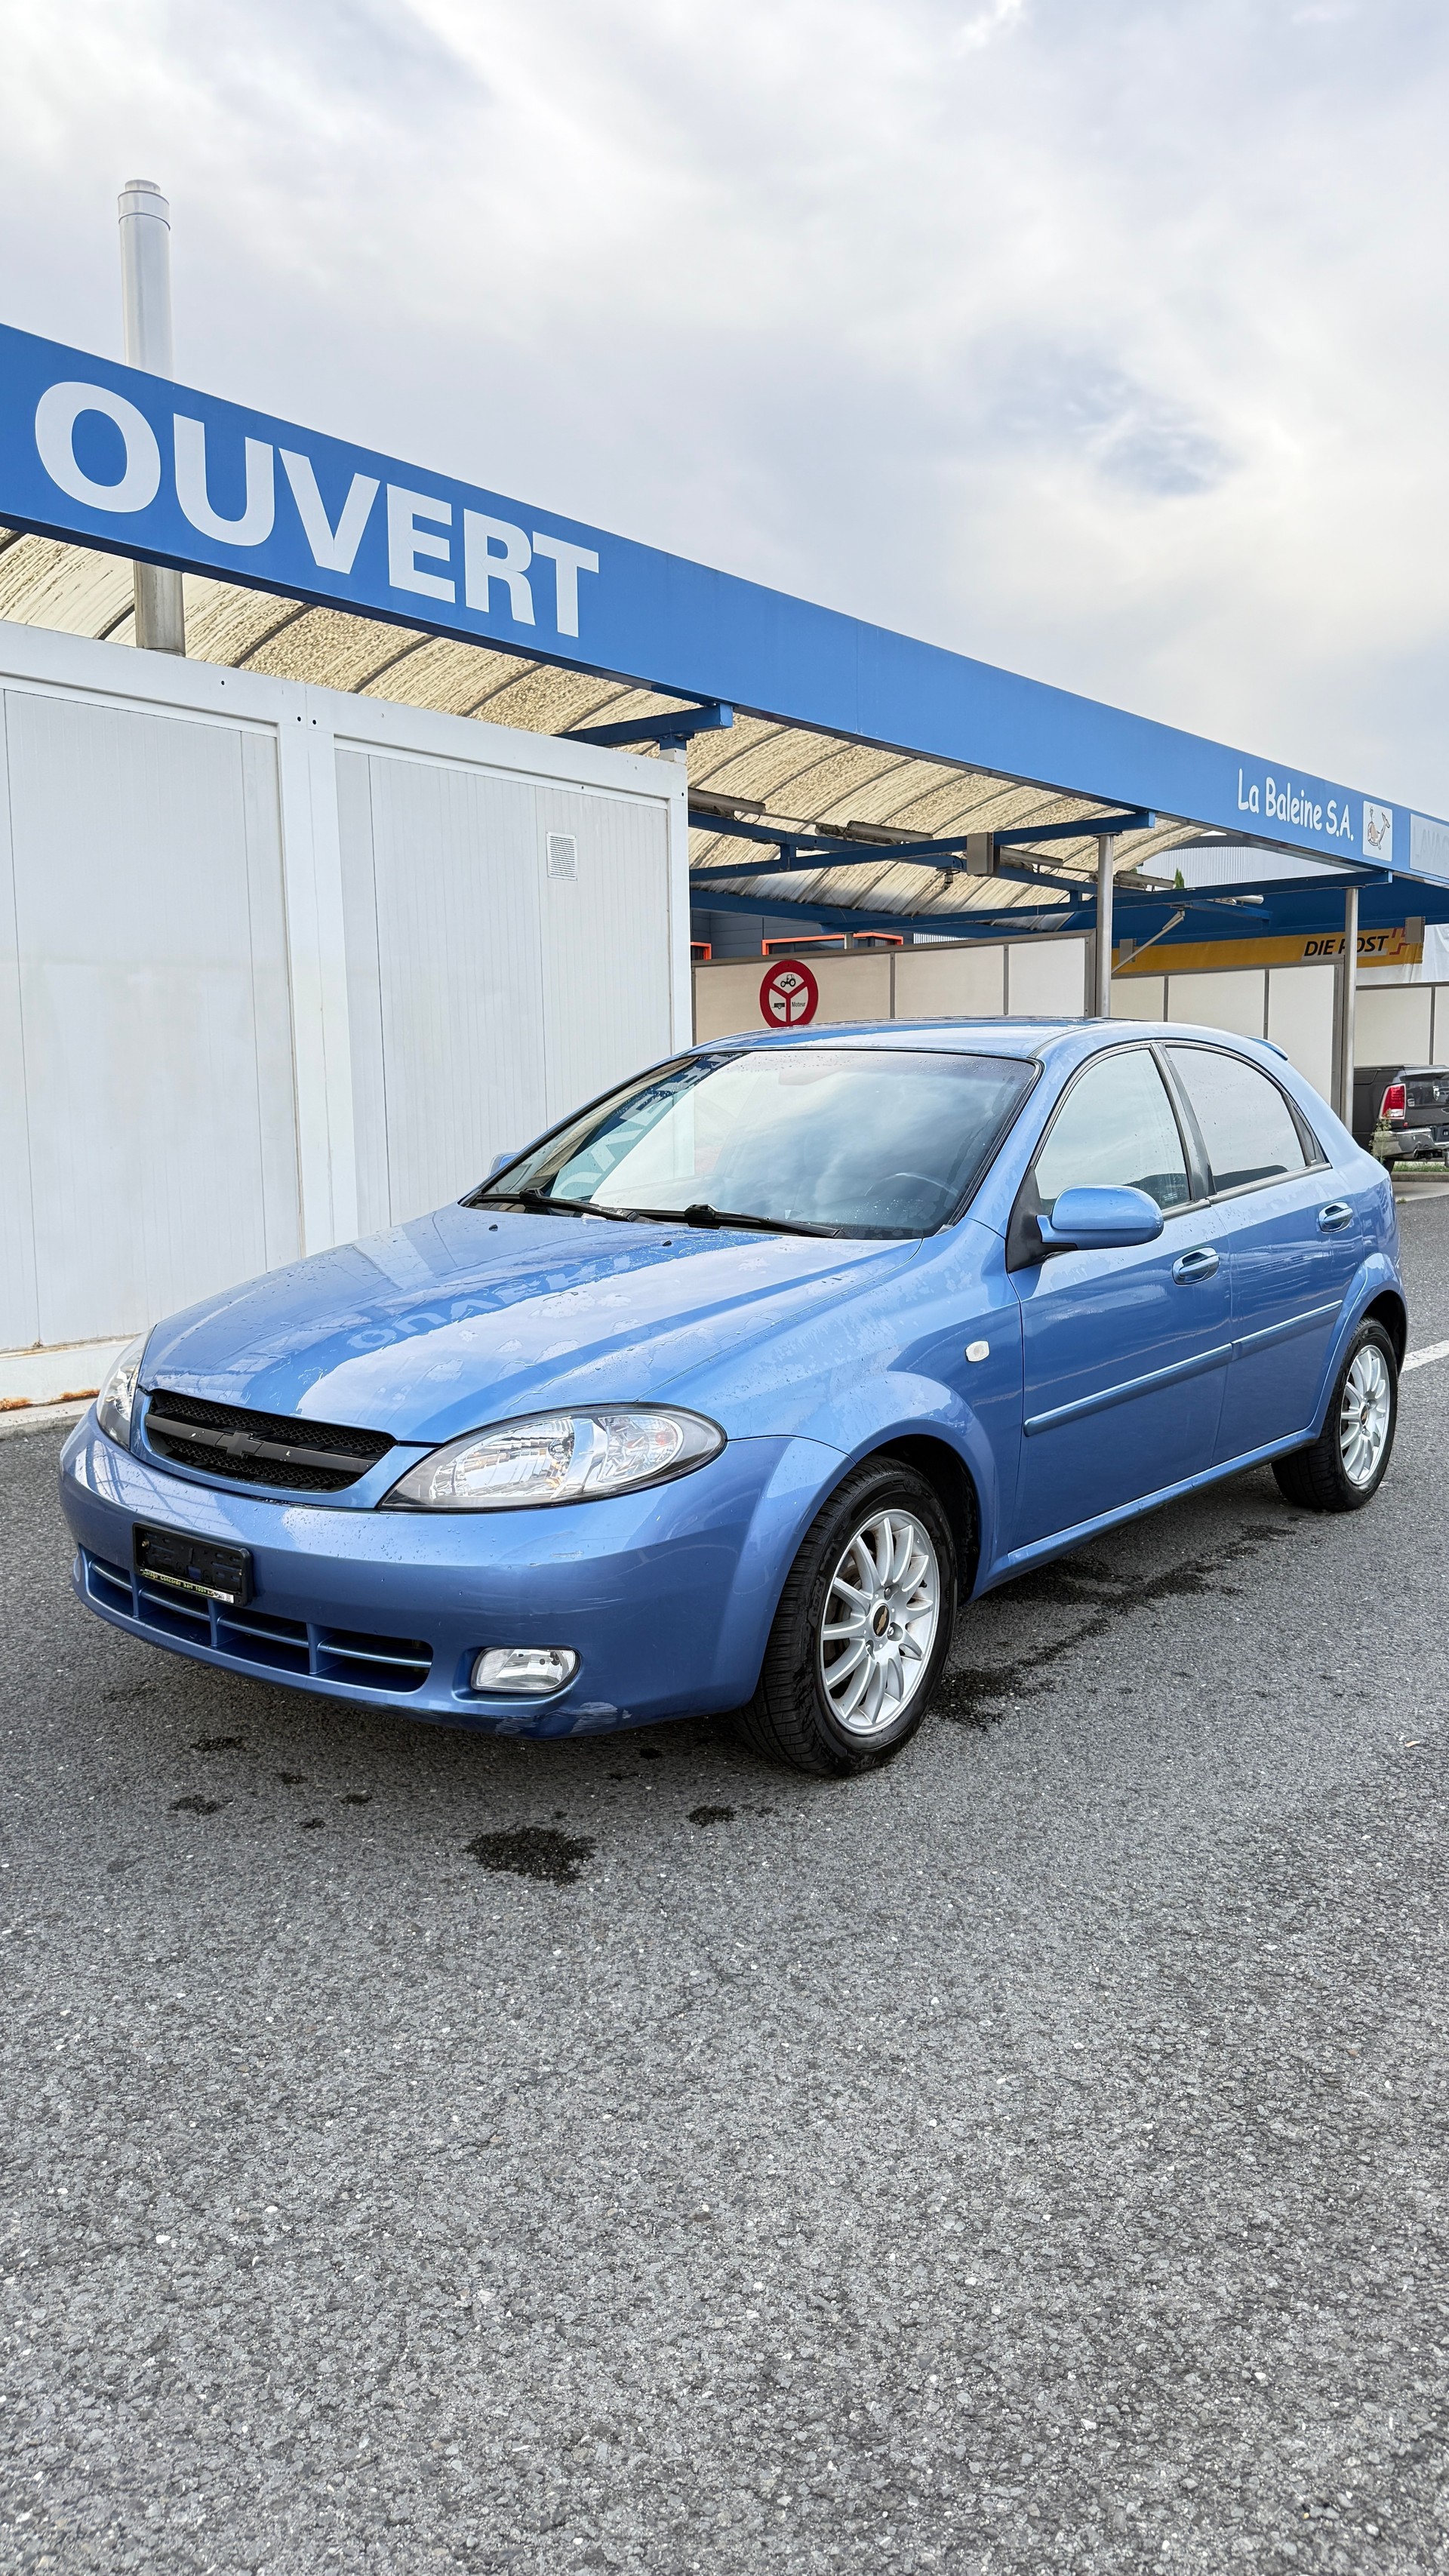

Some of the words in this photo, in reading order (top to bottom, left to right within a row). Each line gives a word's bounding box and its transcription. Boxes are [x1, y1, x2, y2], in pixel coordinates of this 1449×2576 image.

[35, 381, 599, 638] OUVERT
[1238, 768, 1260, 814] La
[1266, 777, 1322, 831] Baleine
[1326, 800, 1354, 841] S.A.
[1304, 940, 1336, 956] DIE
